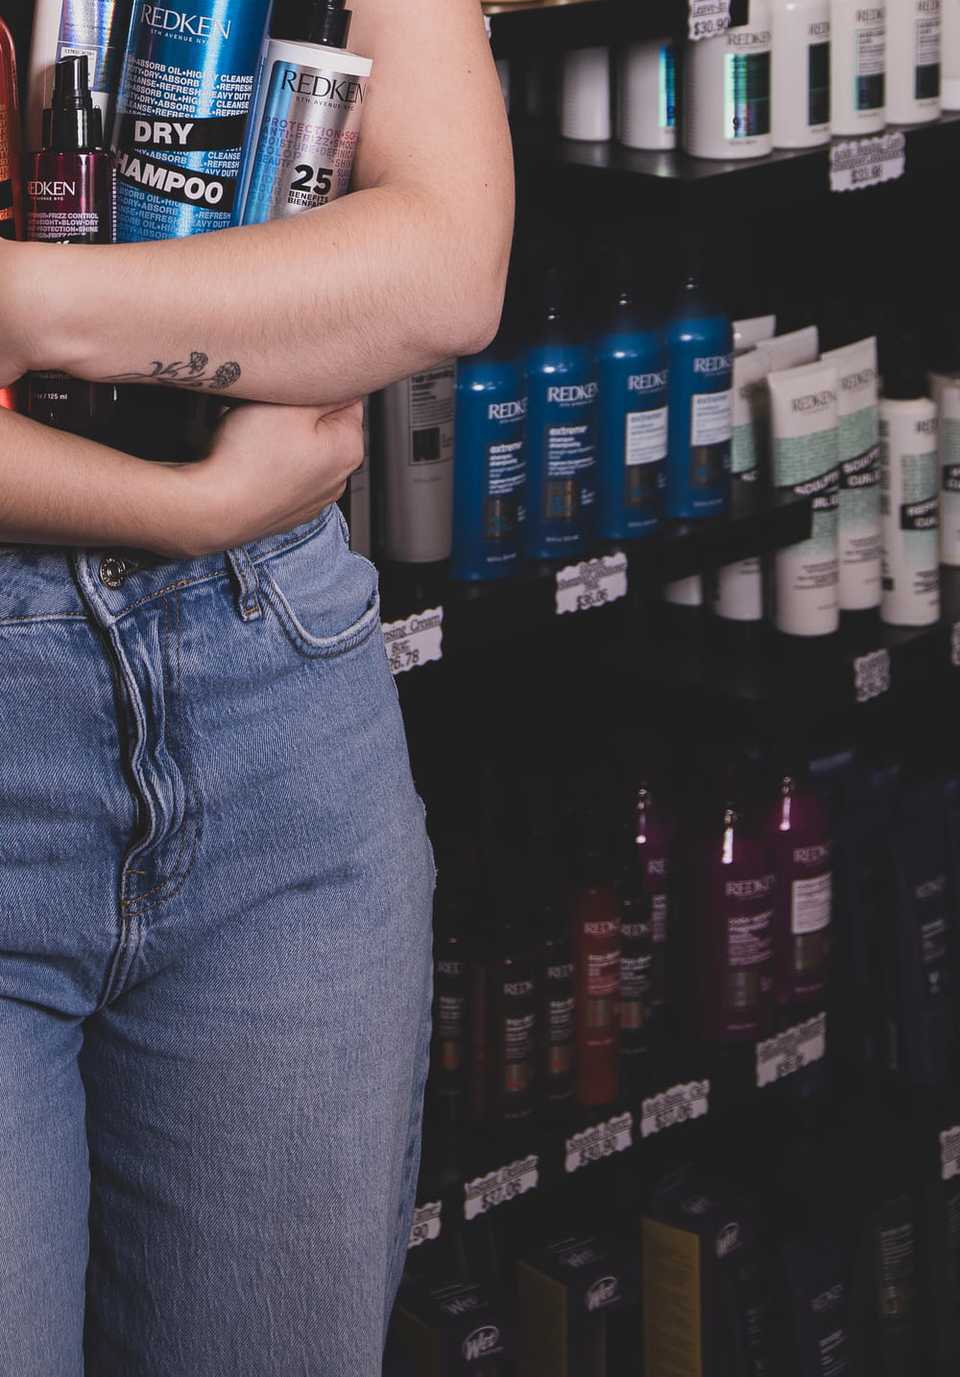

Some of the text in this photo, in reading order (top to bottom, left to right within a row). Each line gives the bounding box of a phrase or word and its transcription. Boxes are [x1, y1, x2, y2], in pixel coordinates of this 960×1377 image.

[141, 3, 232, 41] REDKEN
[165, 32, 193, 44] AVENUE
[220, 73, 254, 86] CLEANSE
[281, 69, 366, 105] REDKEN
[134, 119, 195, 145] DRY
[290, 163, 334, 196] 25
[288, 189, 329, 205] BENEFITS
